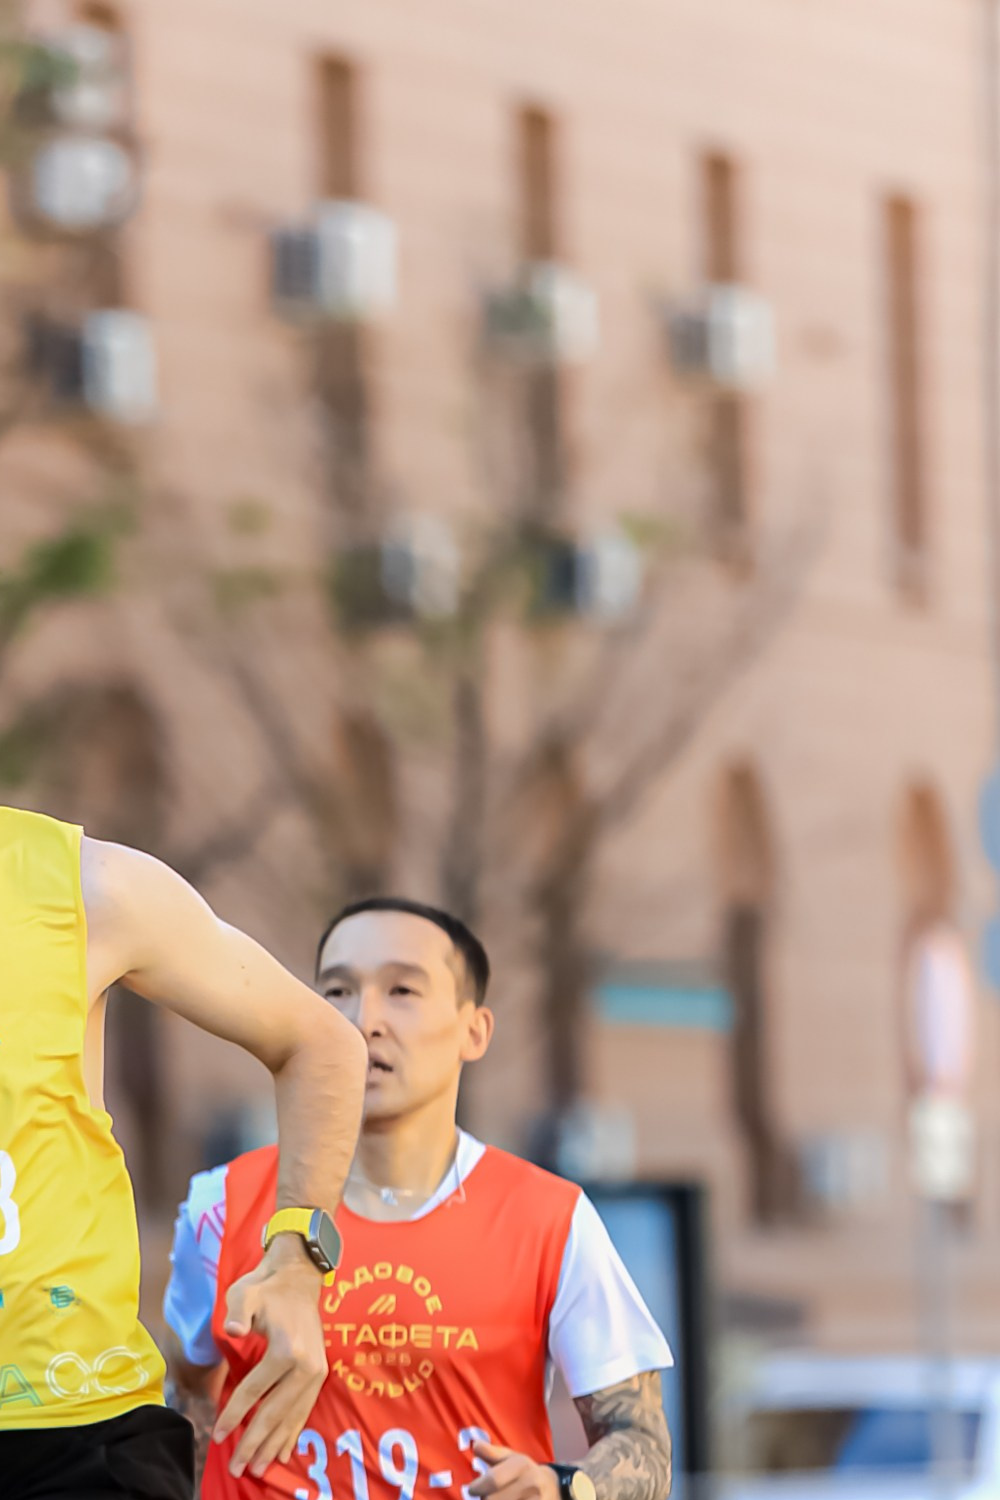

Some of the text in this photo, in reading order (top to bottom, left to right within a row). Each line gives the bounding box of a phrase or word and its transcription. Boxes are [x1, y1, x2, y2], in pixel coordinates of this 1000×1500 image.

[324, 1261, 443, 1315] САДОВОЕ
[322, 1322, 479, 1351] ТАФЕТА
[333, 1359, 435, 1398] КОЛЬЦО
